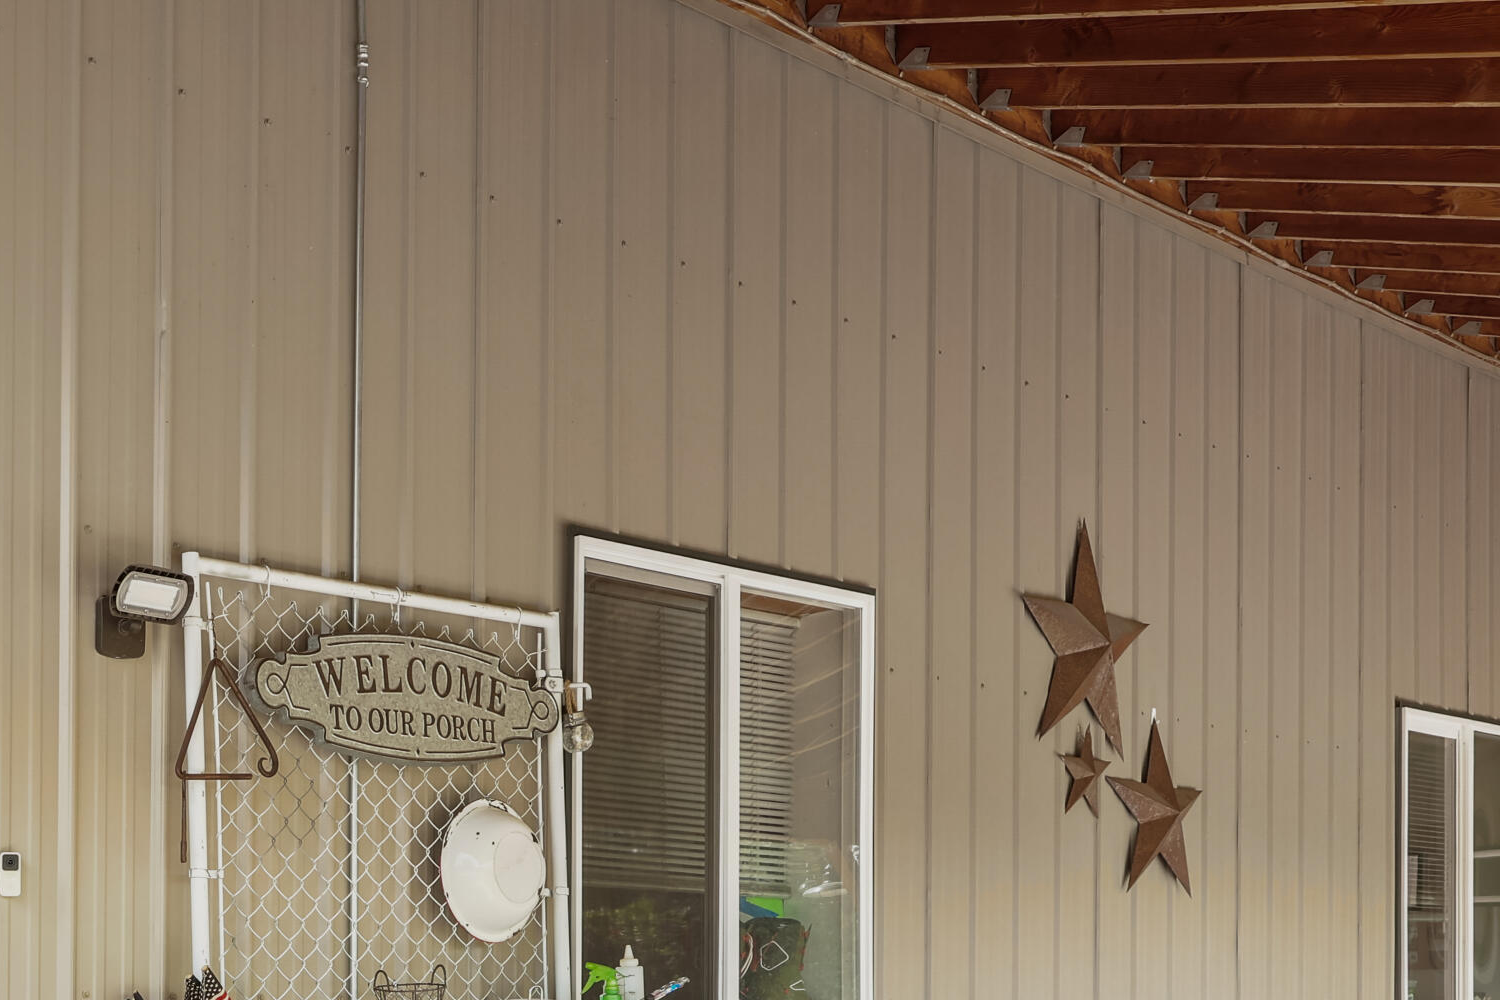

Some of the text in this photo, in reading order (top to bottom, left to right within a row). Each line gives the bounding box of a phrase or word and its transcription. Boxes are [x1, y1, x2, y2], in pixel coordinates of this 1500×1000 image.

[312, 654, 507, 718] WELCOME
[329, 704, 496, 744] TO OUR PORCH
